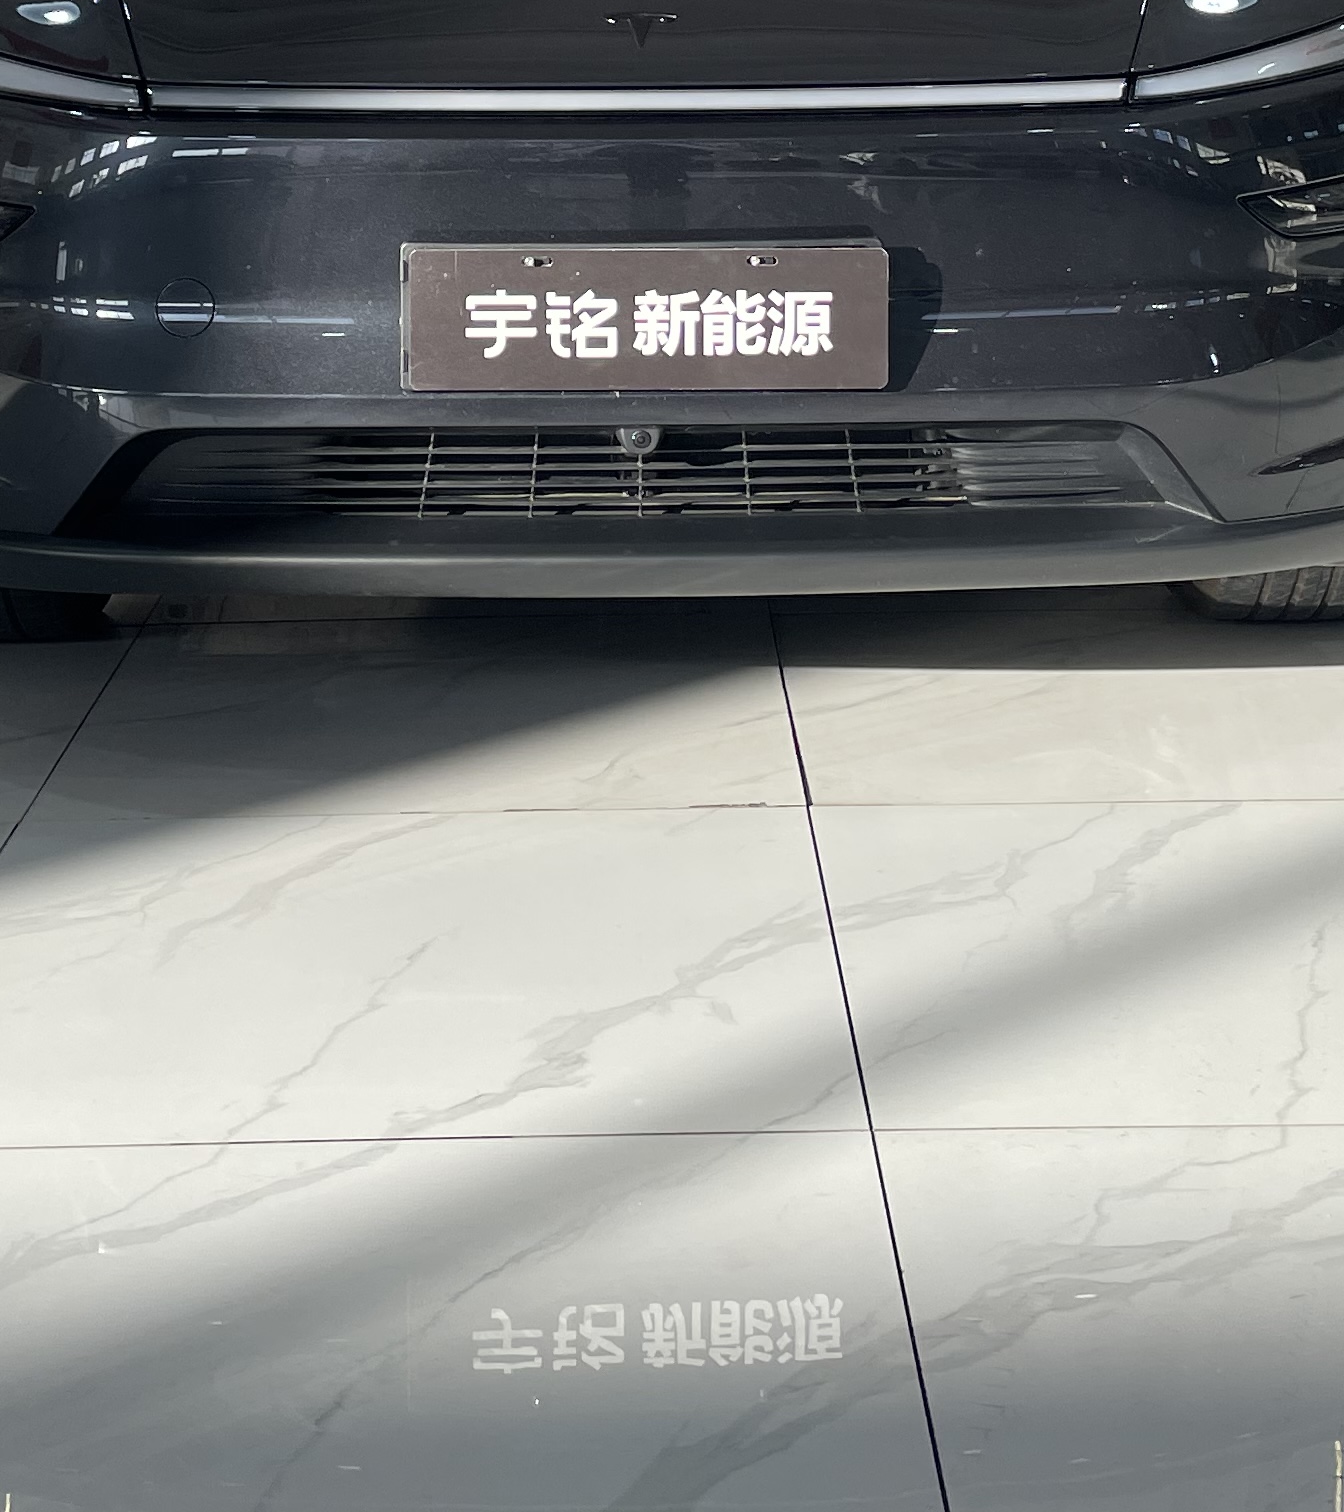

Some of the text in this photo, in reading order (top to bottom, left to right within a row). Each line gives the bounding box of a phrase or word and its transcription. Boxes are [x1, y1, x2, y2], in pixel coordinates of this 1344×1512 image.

[464, 289, 833, 359] 宇铭 新能源
